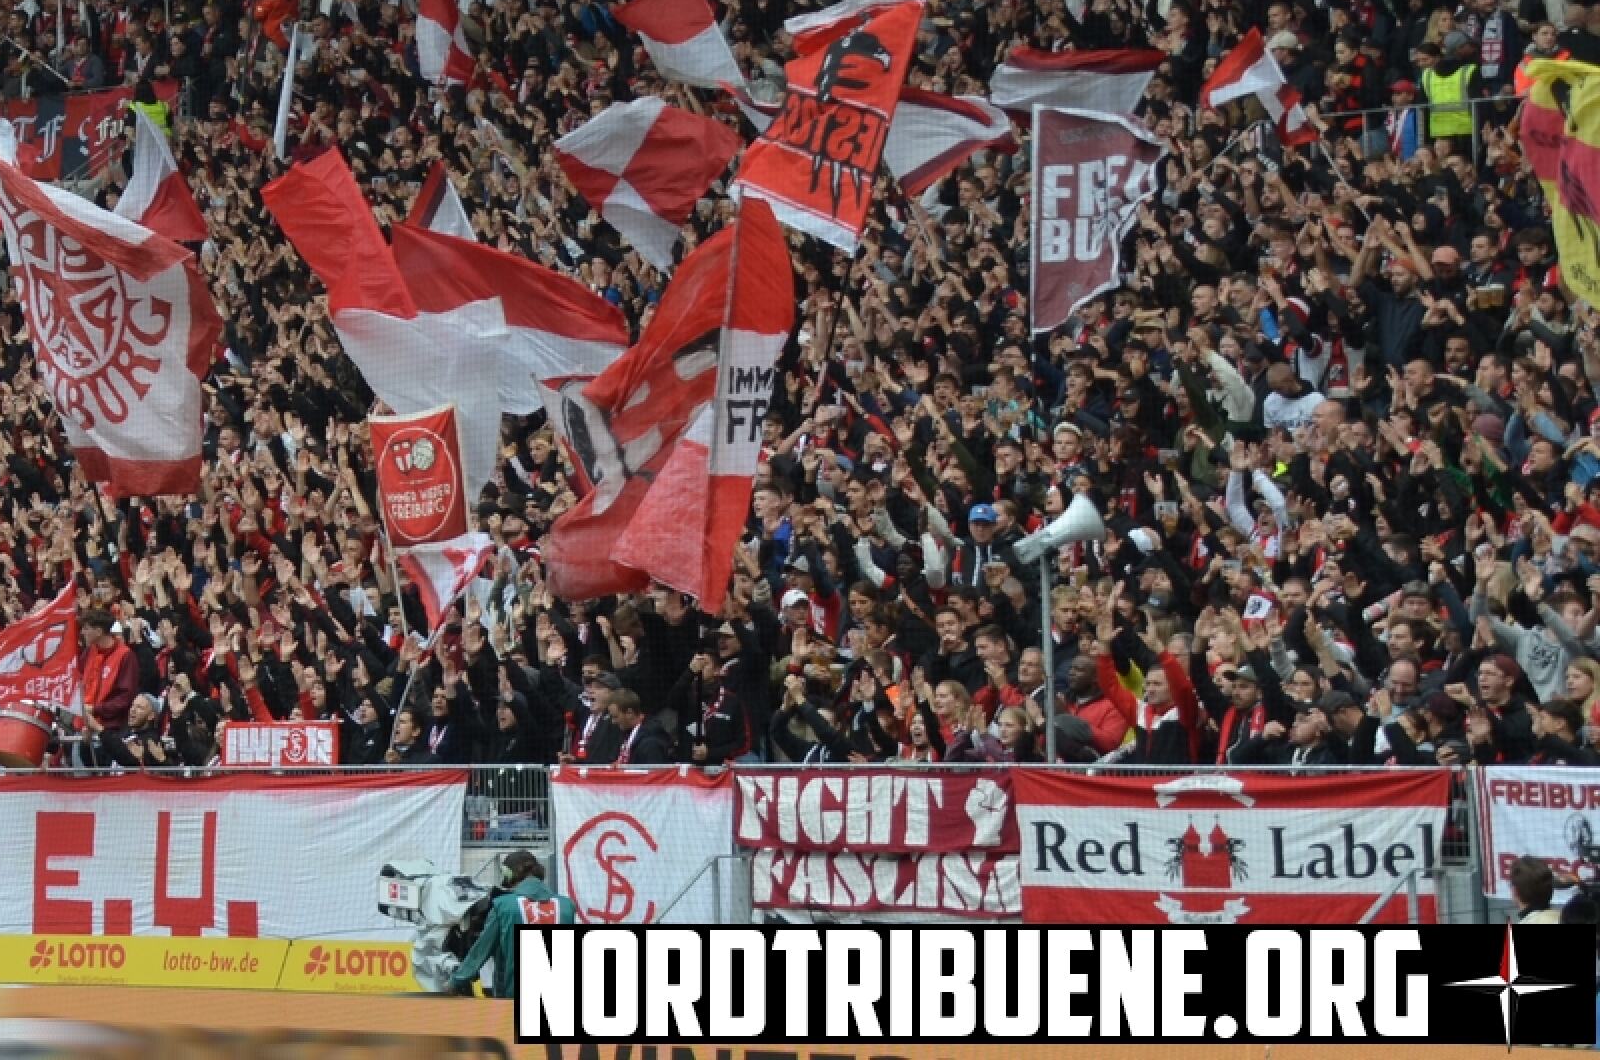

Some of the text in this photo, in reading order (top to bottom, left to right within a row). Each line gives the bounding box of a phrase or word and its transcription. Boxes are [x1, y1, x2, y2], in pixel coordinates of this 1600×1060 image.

[728, 365, 776, 395] IMM
[391, 497, 445, 519] FREIBURG
[1489, 778, 1600, 810] FREIBUR
[736, 775, 944, 847] FIGHT
[1031, 821, 1438, 881] Red Label
[57, 943, 260, 973] LOTTO lotto-bw.de
[334, 949, 409, 977] LOTTO
